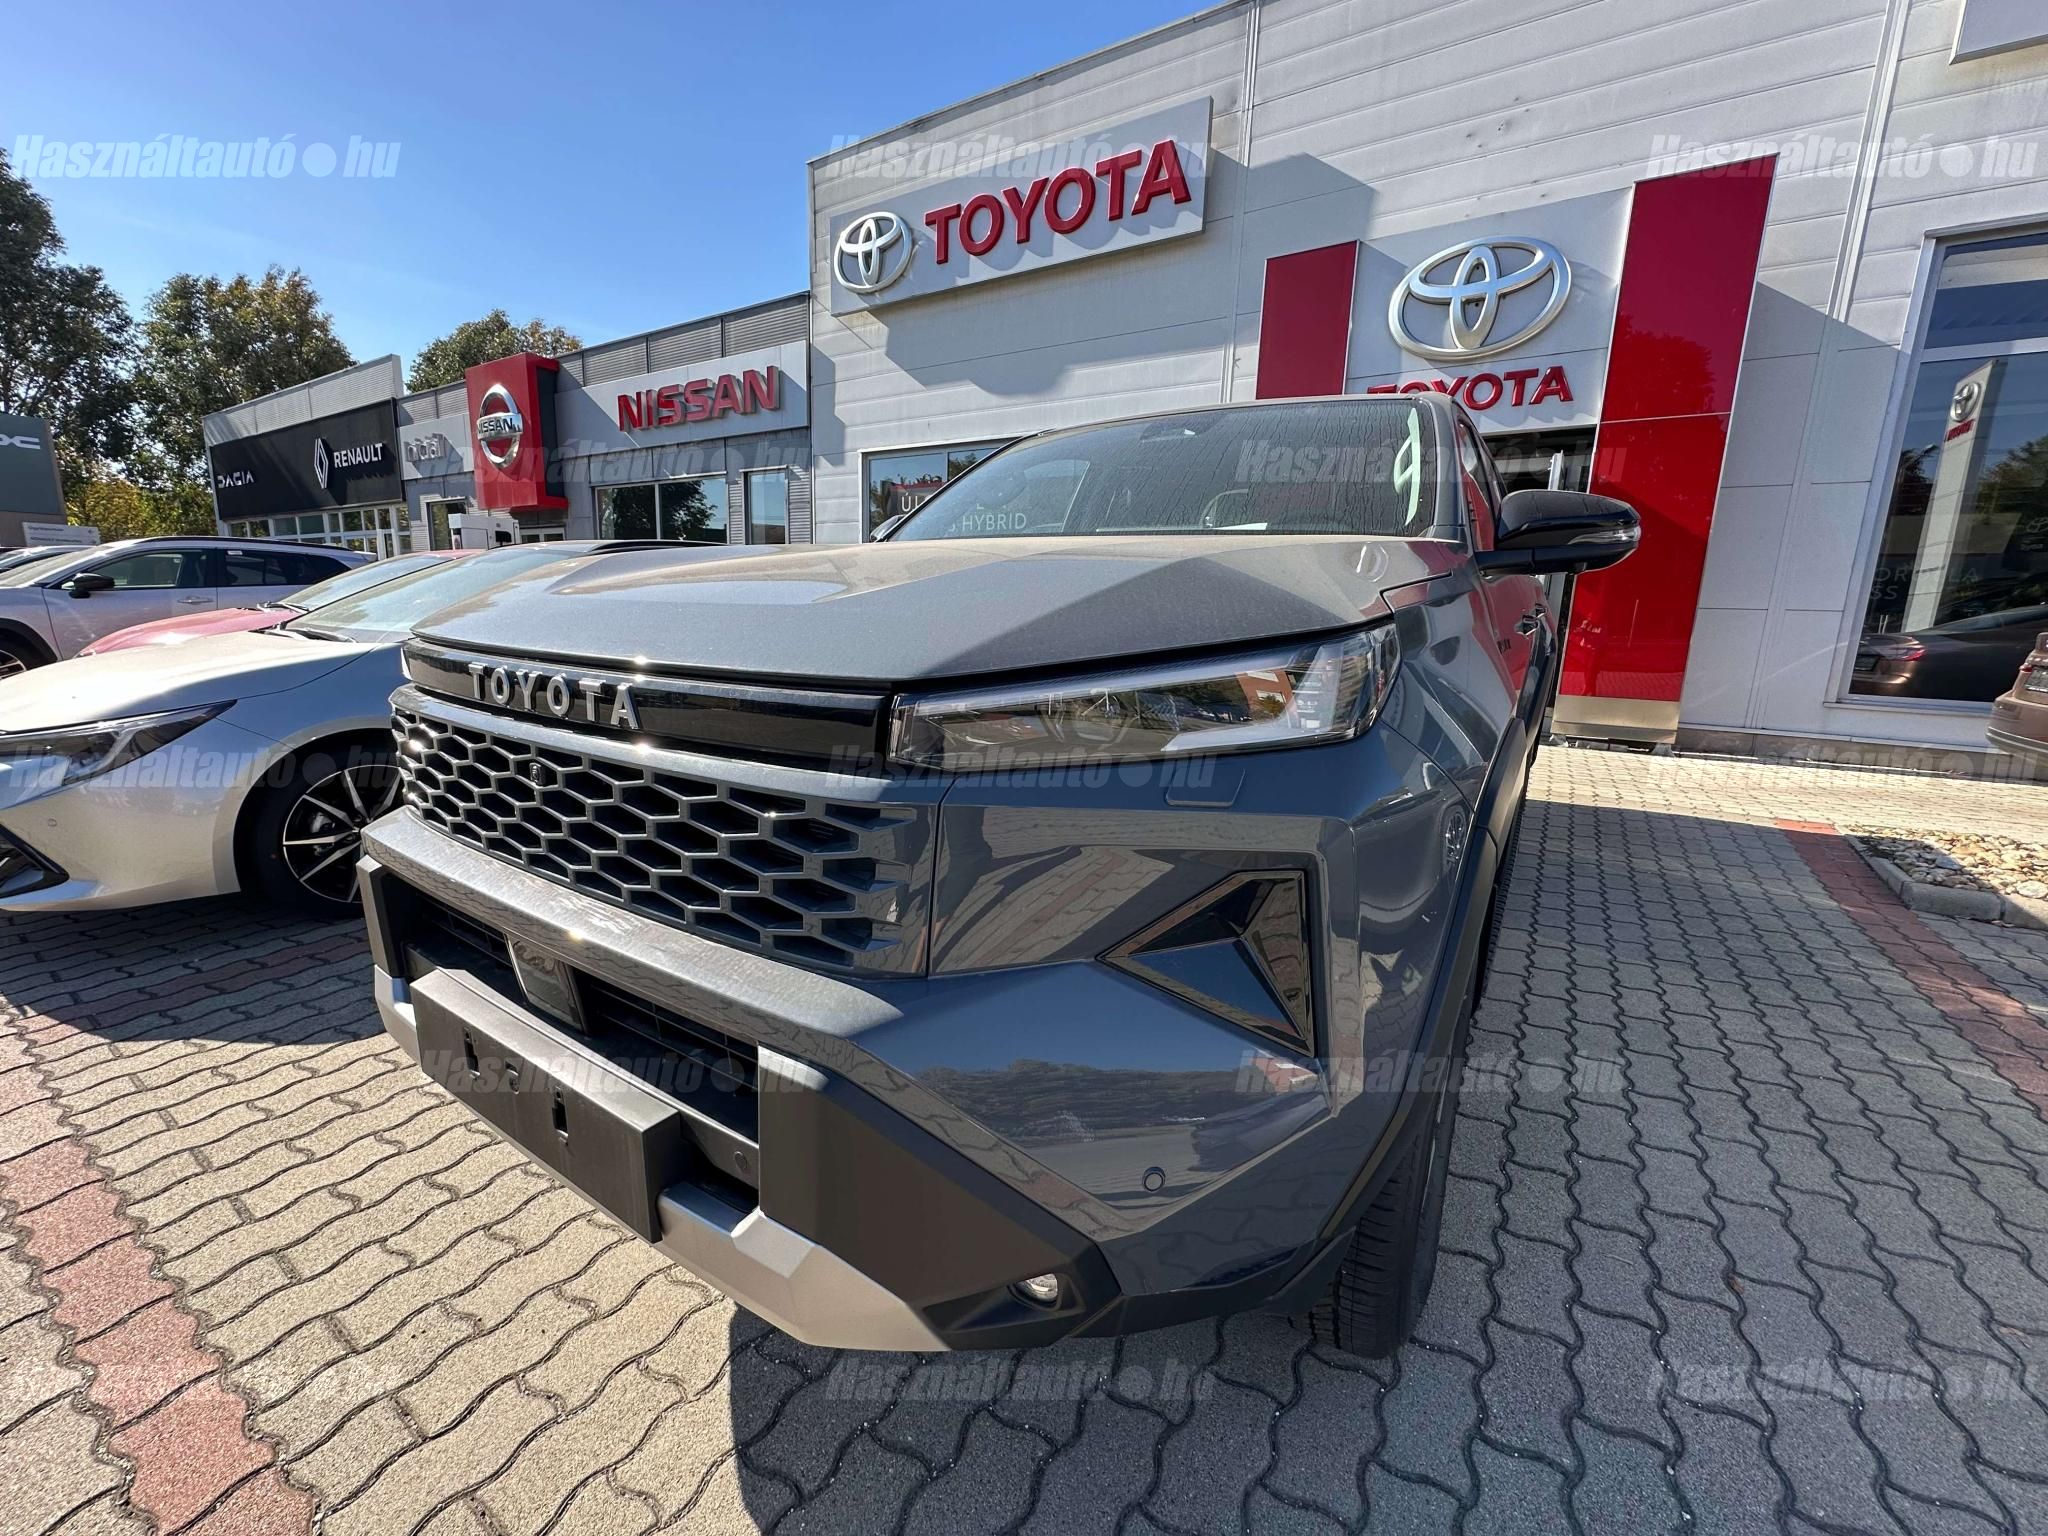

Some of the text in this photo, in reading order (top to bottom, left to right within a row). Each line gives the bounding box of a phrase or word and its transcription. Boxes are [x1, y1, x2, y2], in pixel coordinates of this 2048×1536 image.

[924, 139, 1192, 264] TOYOTA
[617, 365, 780, 431] NISSAN
[1367, 365, 1573, 411] YOTA
[478, 417, 513, 434] NISSAN
[333, 443, 383, 468] RENAULT
[217, 471, 255, 488] DACIA
[962, 513, 1027, 532] HYBRID
[468, 663, 641, 729] TOYOTA
